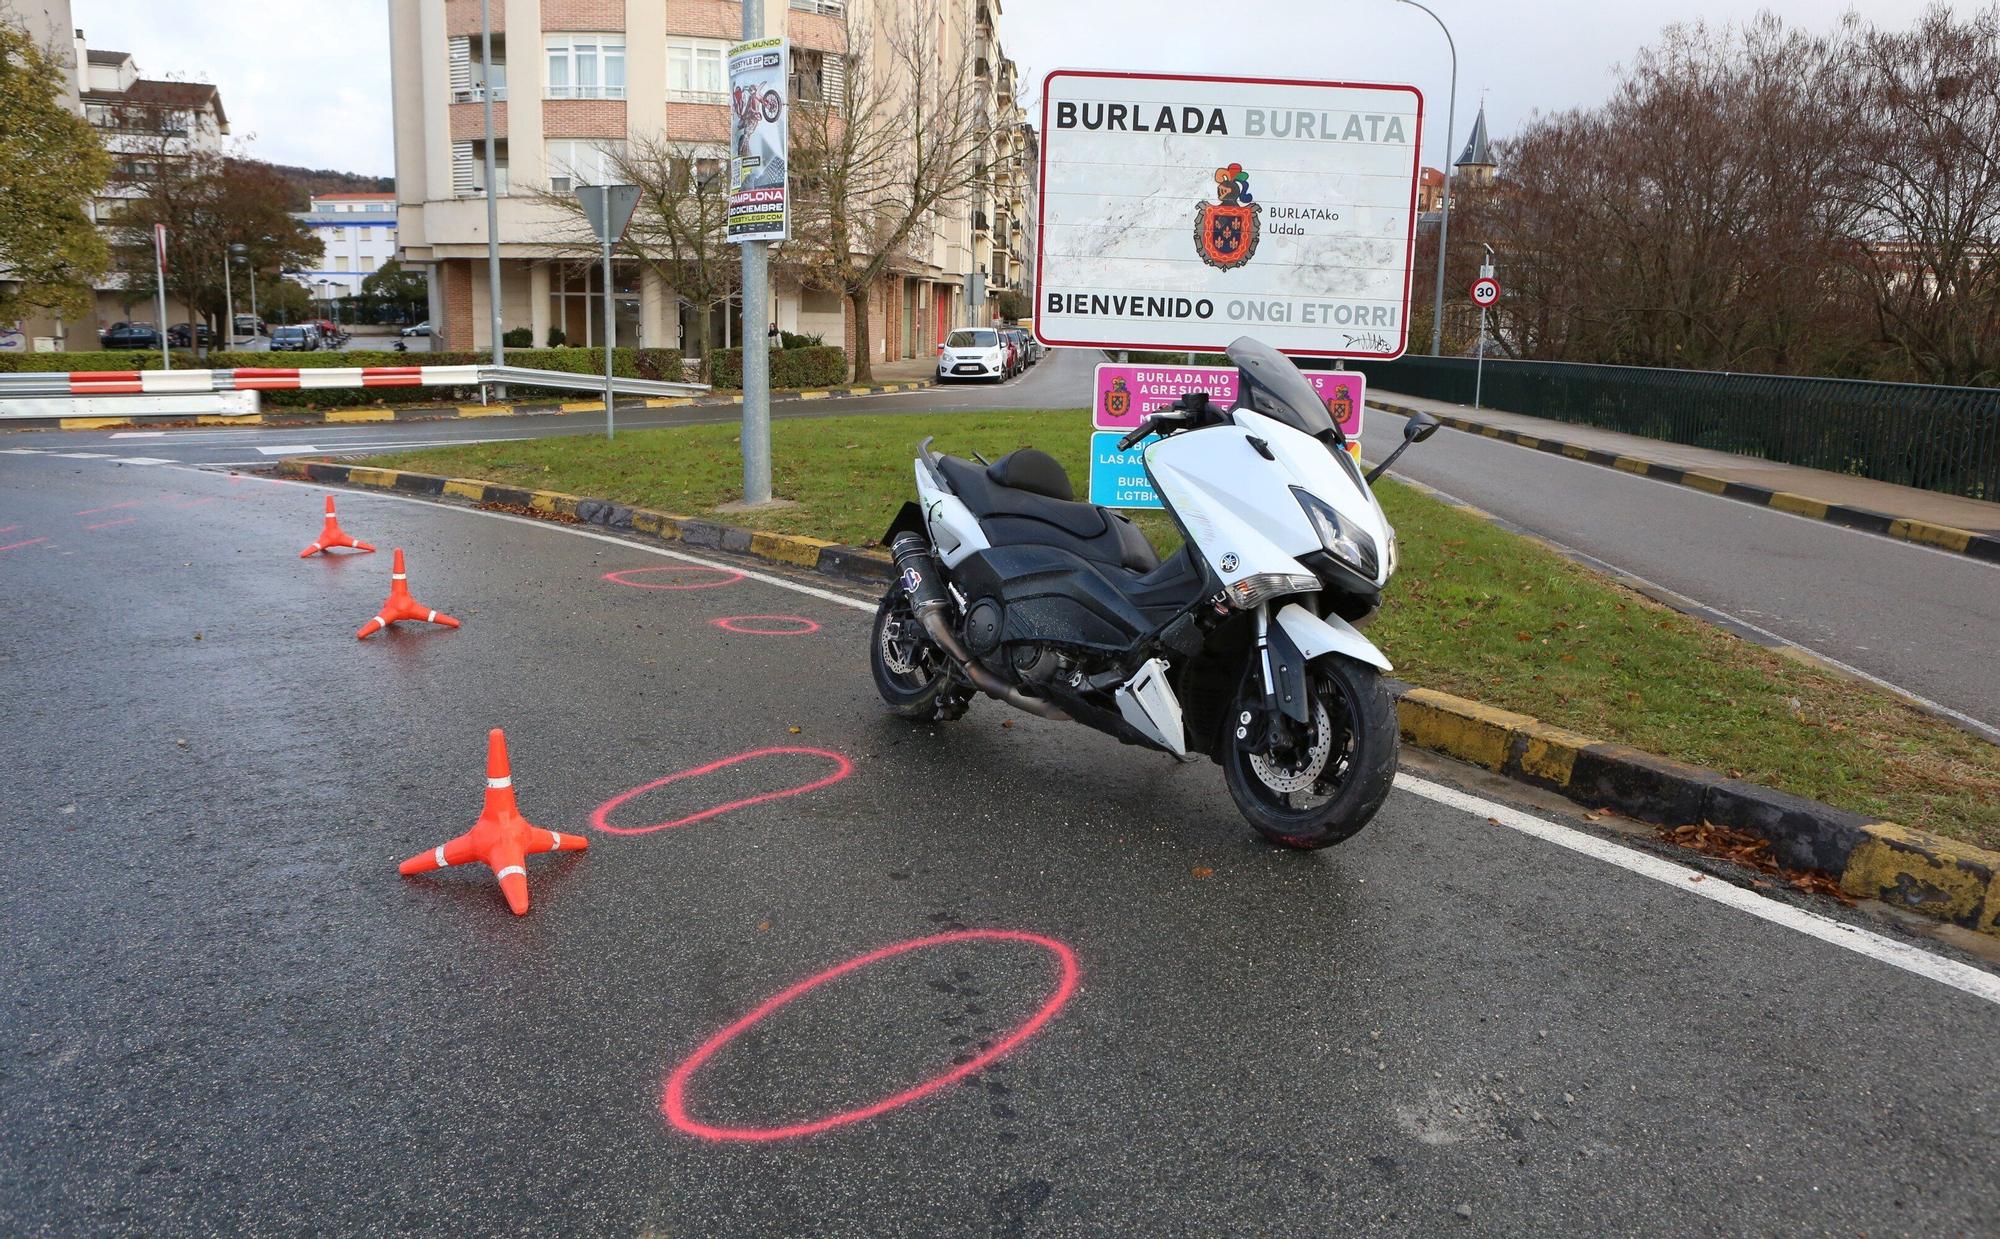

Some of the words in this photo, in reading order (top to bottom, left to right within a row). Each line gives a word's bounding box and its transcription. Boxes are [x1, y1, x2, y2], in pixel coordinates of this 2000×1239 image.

[740, 44, 751, 52] DEL
[753, 38, 780, 47] MUNDO
[753, 56, 762, 65] GP
[763, 58, 779, 66] CUP
[1056, 102, 1229, 136] BURLADA
[1244, 109, 1406, 144] BURLATA
[730, 190, 783, 205] PAMPLONA
[736, 203, 783, 215] DICIEMBRE
[1270, 206, 1339, 221] BURLATAko
[1269, 222, 1305, 236] Udala
[1477, 287, 1494, 297] 30
[1047, 292, 1215, 320] BIENVENIDO
[1226, 299, 1293, 323] ONGI
[1302, 303, 1396, 327] ETORRI
[1136, 372, 1203, 384] BURLADA
[1208, 374, 1230, 384] NO
[1139, 384, 1232, 397] AGRESIONES
[1100, 454, 1125, 465] LAS
[1118, 476, 1152, 488] BURL
